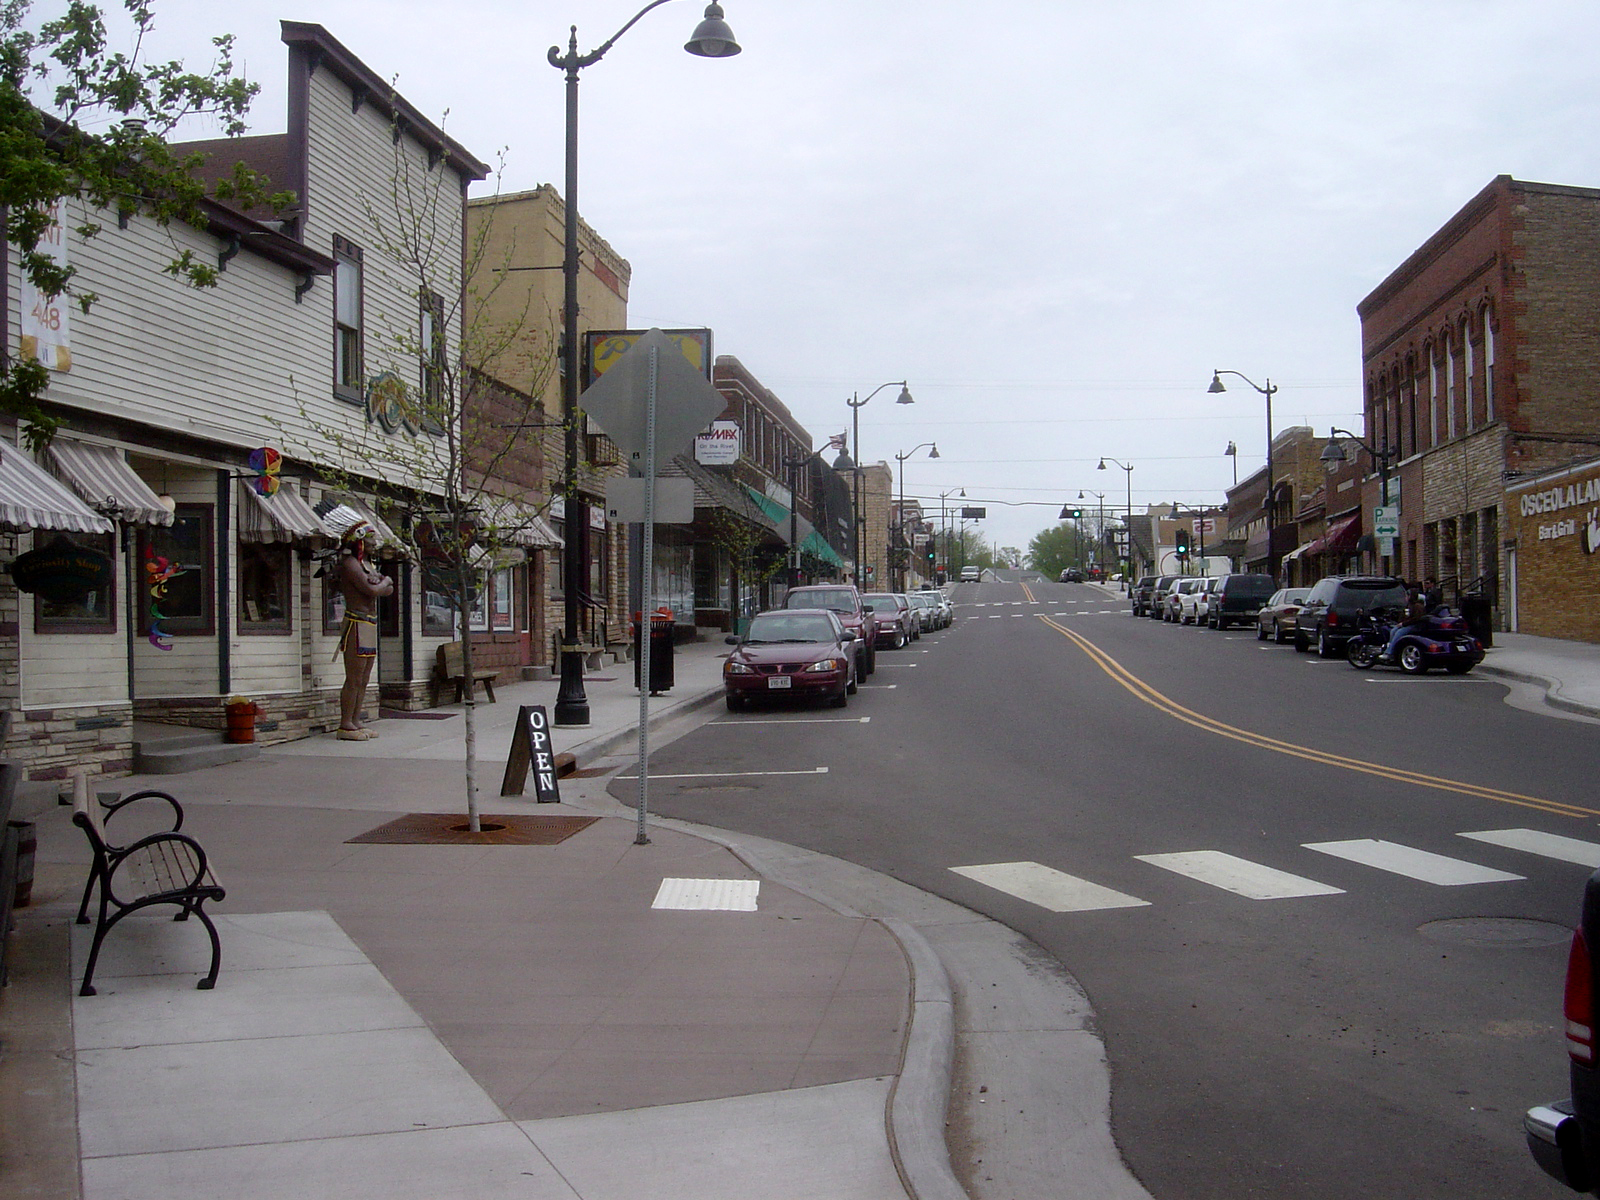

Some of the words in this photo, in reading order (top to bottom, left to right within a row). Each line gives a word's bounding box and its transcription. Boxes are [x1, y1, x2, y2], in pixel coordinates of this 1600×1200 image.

[1520, 484, 1577, 517] OSCEOLA
[75, 558, 101, 572] Shop
[530, 711, 554, 791] OPEN
